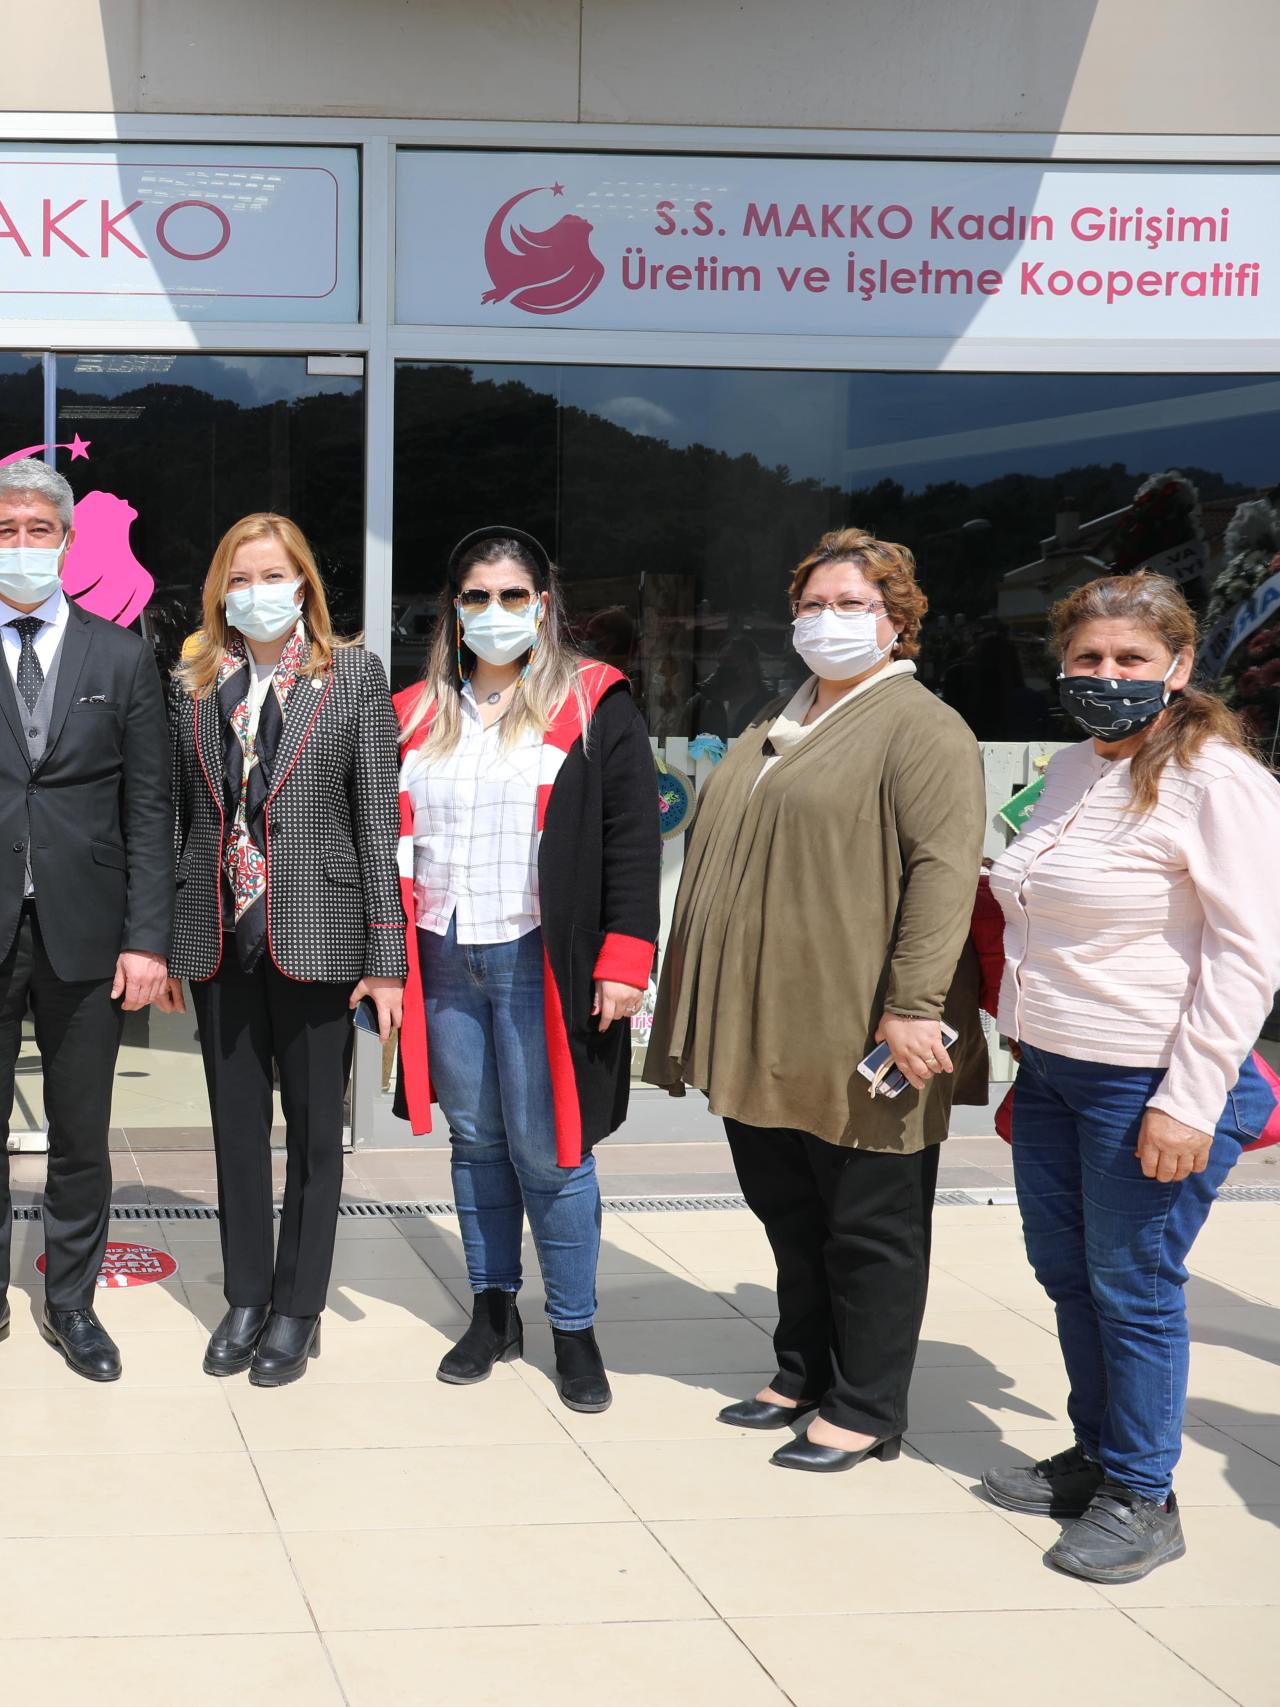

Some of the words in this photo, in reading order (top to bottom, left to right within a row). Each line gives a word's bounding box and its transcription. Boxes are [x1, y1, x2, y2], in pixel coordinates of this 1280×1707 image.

[654, 200, 726, 236] S.S.
[742, 202, 913, 240] MAKKO
[930, 206, 1054, 241] Kadın
[1070, 206, 1230, 250] Girişimi
[621, 247, 762, 292] Üretim
[777, 266, 831, 294] ve
[847, 250, 1004, 302] İşletme
[1020, 261, 1262, 305] Kooperatifi
[101, 1259, 161, 1268] AFEYİ
